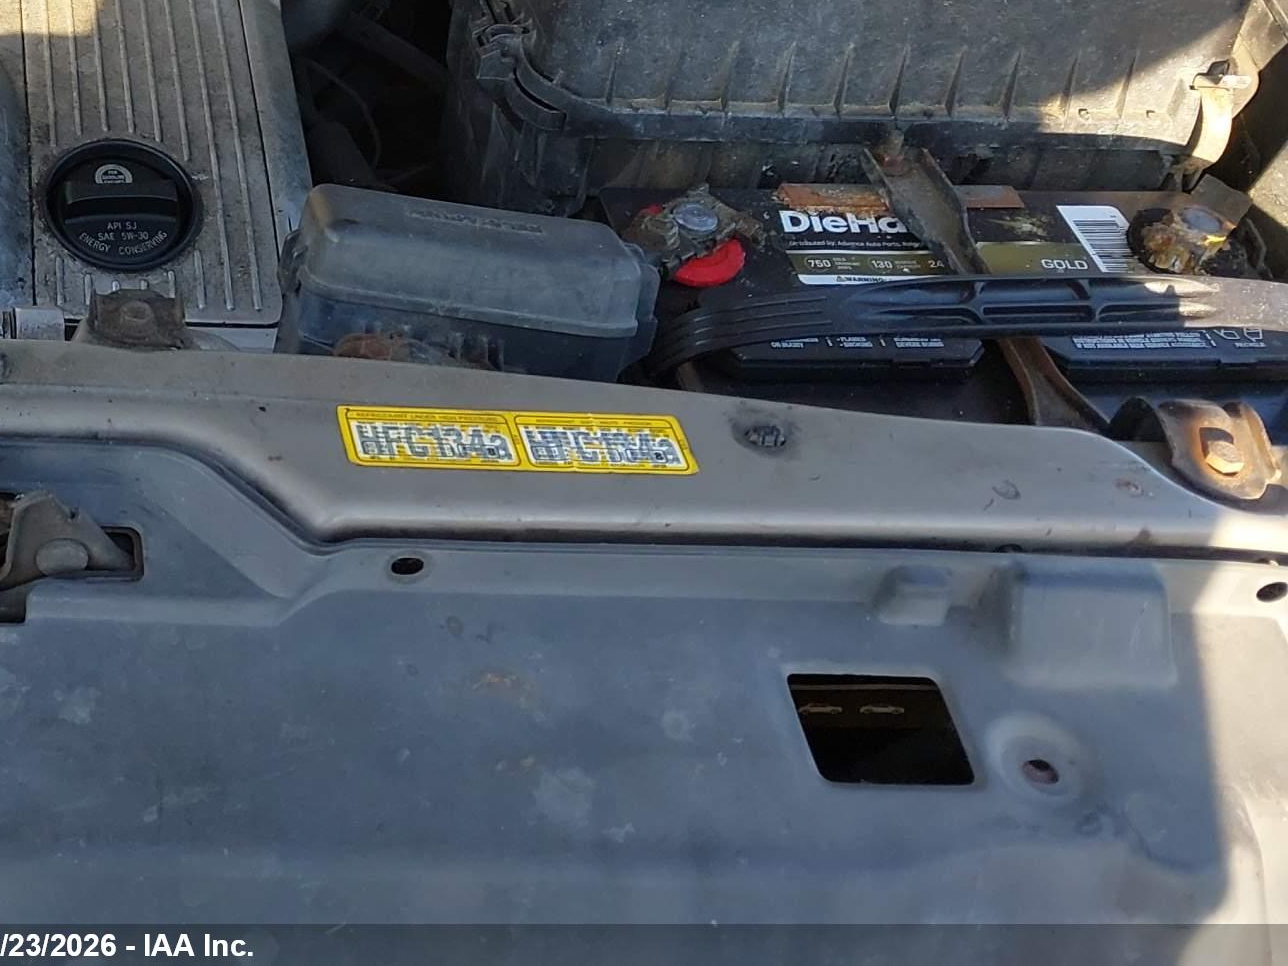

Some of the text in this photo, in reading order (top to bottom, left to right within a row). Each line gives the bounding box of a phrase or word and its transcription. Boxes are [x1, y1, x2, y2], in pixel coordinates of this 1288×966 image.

[107, 221, 137, 230] API SJ
[779, 210, 907, 233] DieHa
[97, 231, 149, 241] SAE 5W-30
[79, 230, 168, 255] ENERGY CONSERVING
[808, 259, 831, 268] 750
[872, 260, 893, 269] 130
[1041, 259, 1089, 270] GOLD
